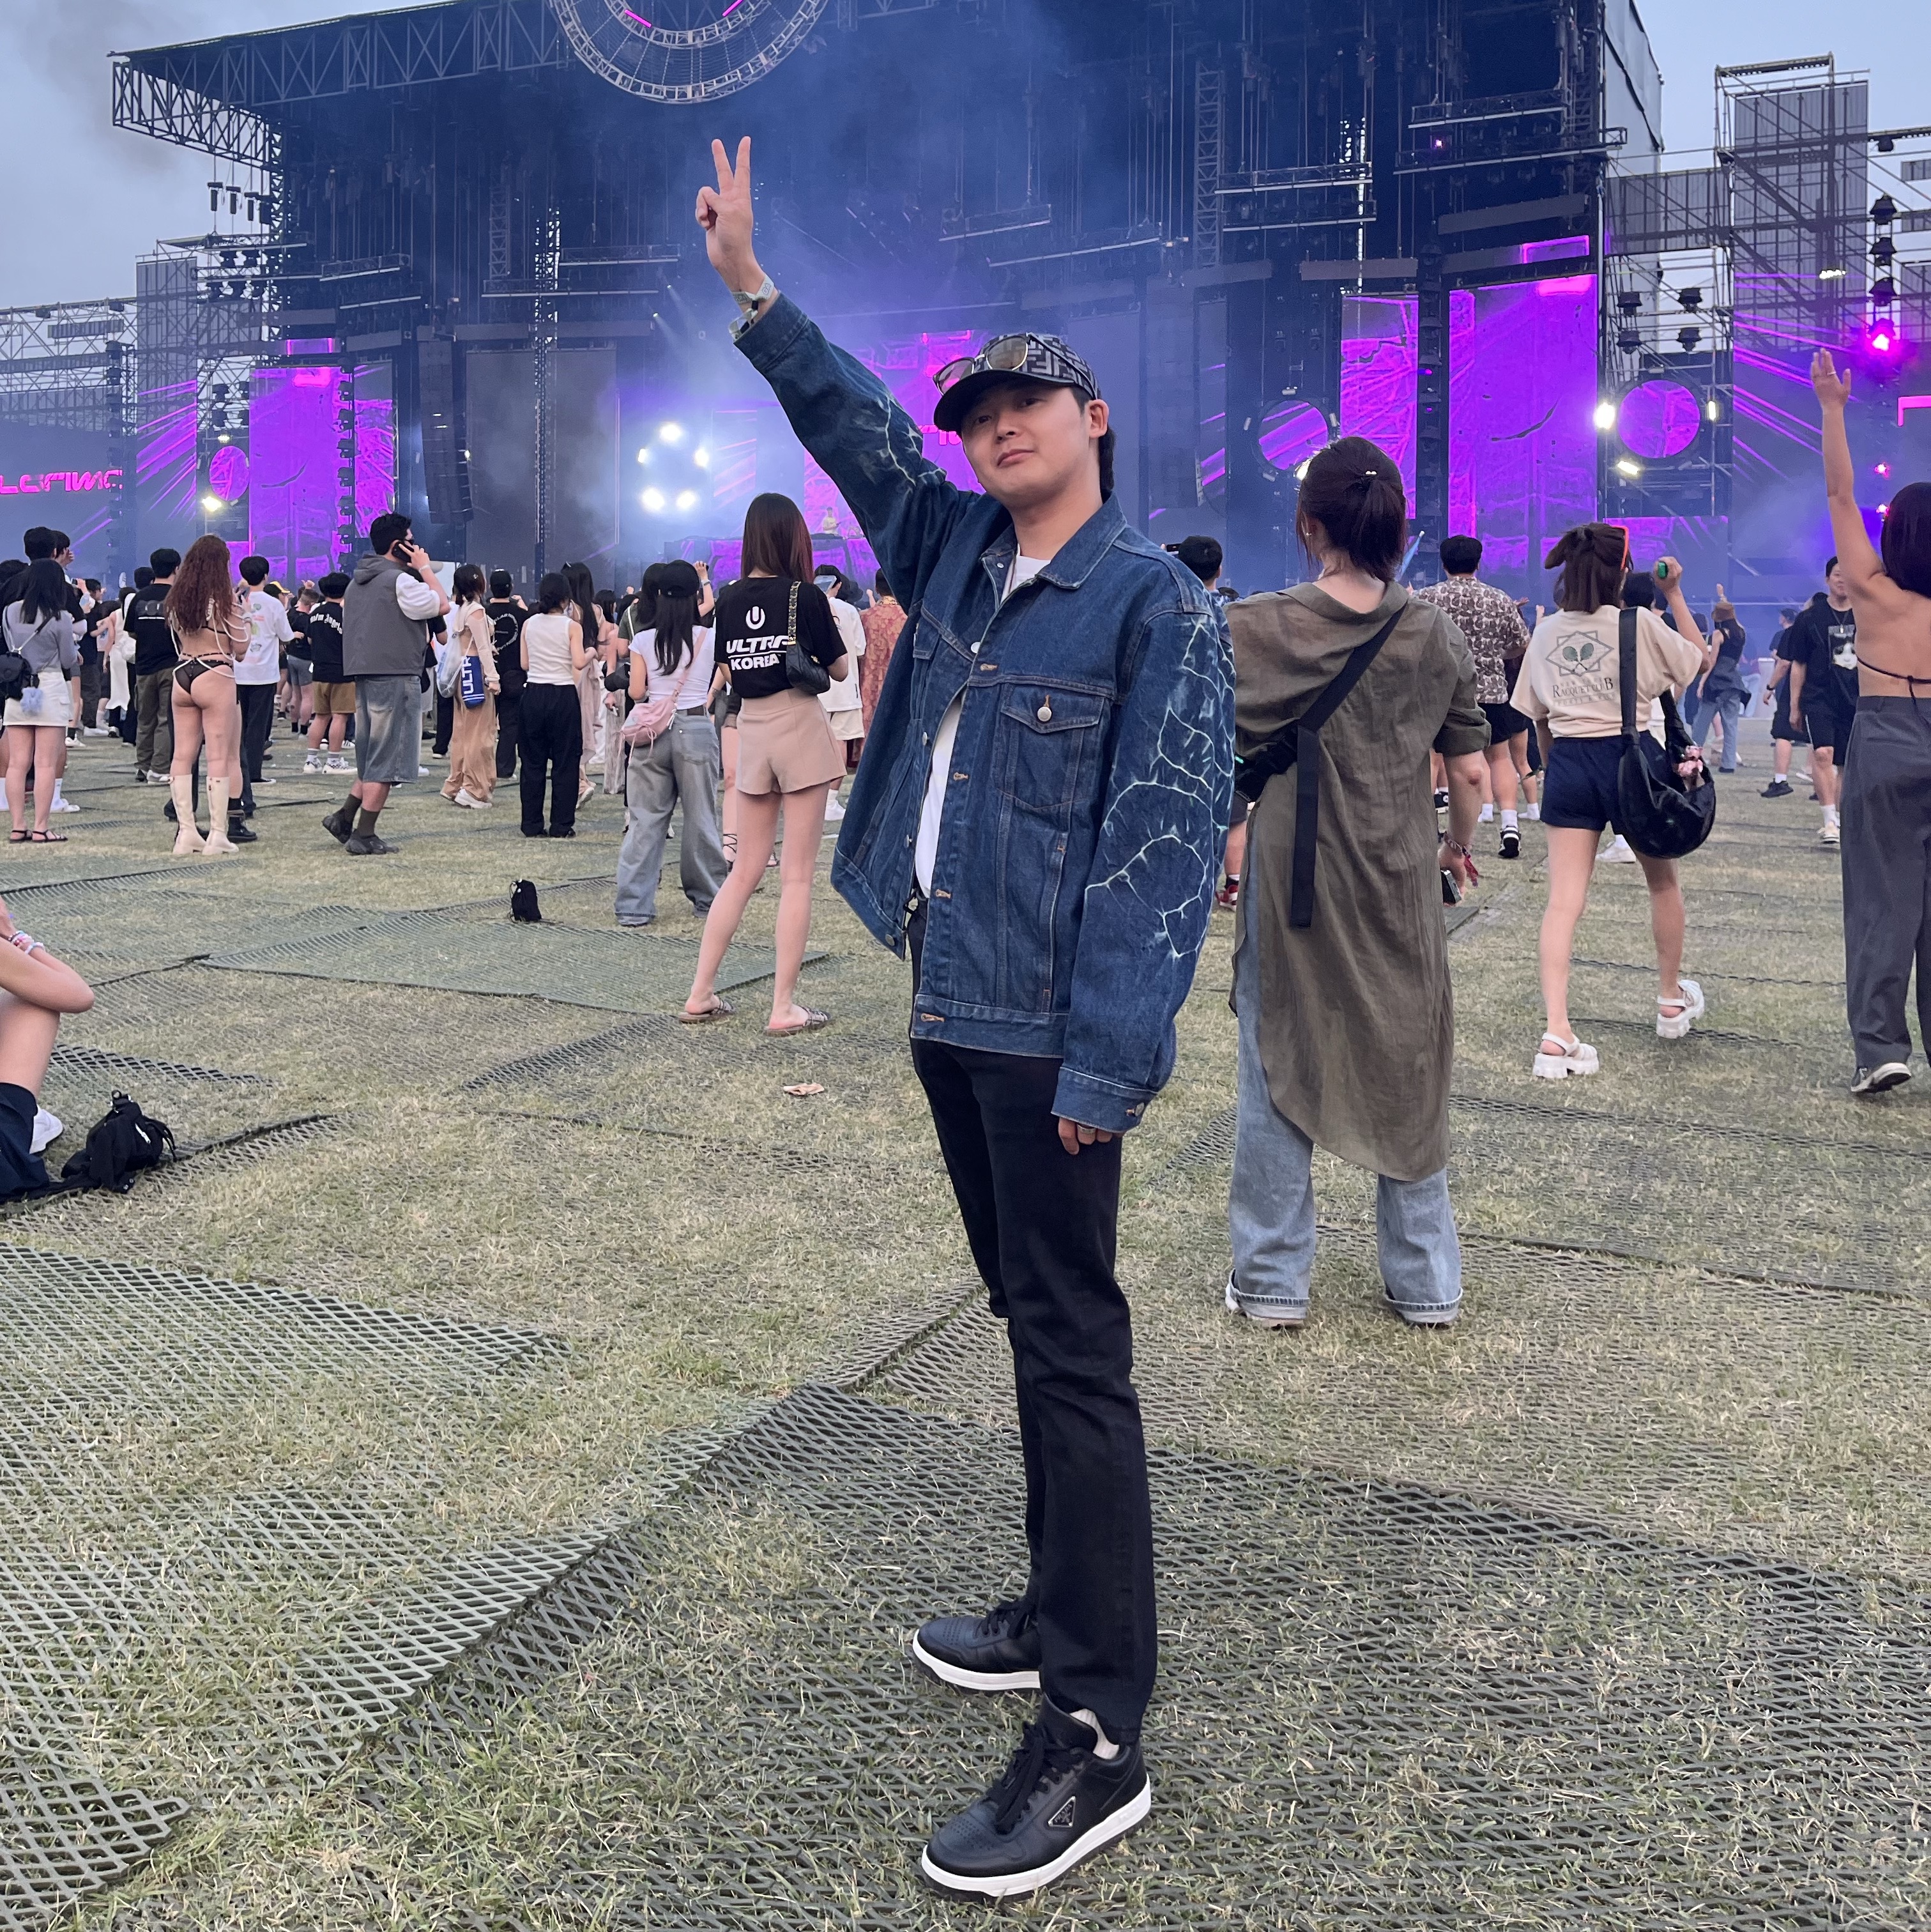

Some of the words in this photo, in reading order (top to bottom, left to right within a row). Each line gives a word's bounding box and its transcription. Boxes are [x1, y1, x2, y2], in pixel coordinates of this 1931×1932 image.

[731, 653, 780, 671] KOREA
[462, 657, 474, 694] ULTR
[1553, 684, 1589, 698] RACQUET
